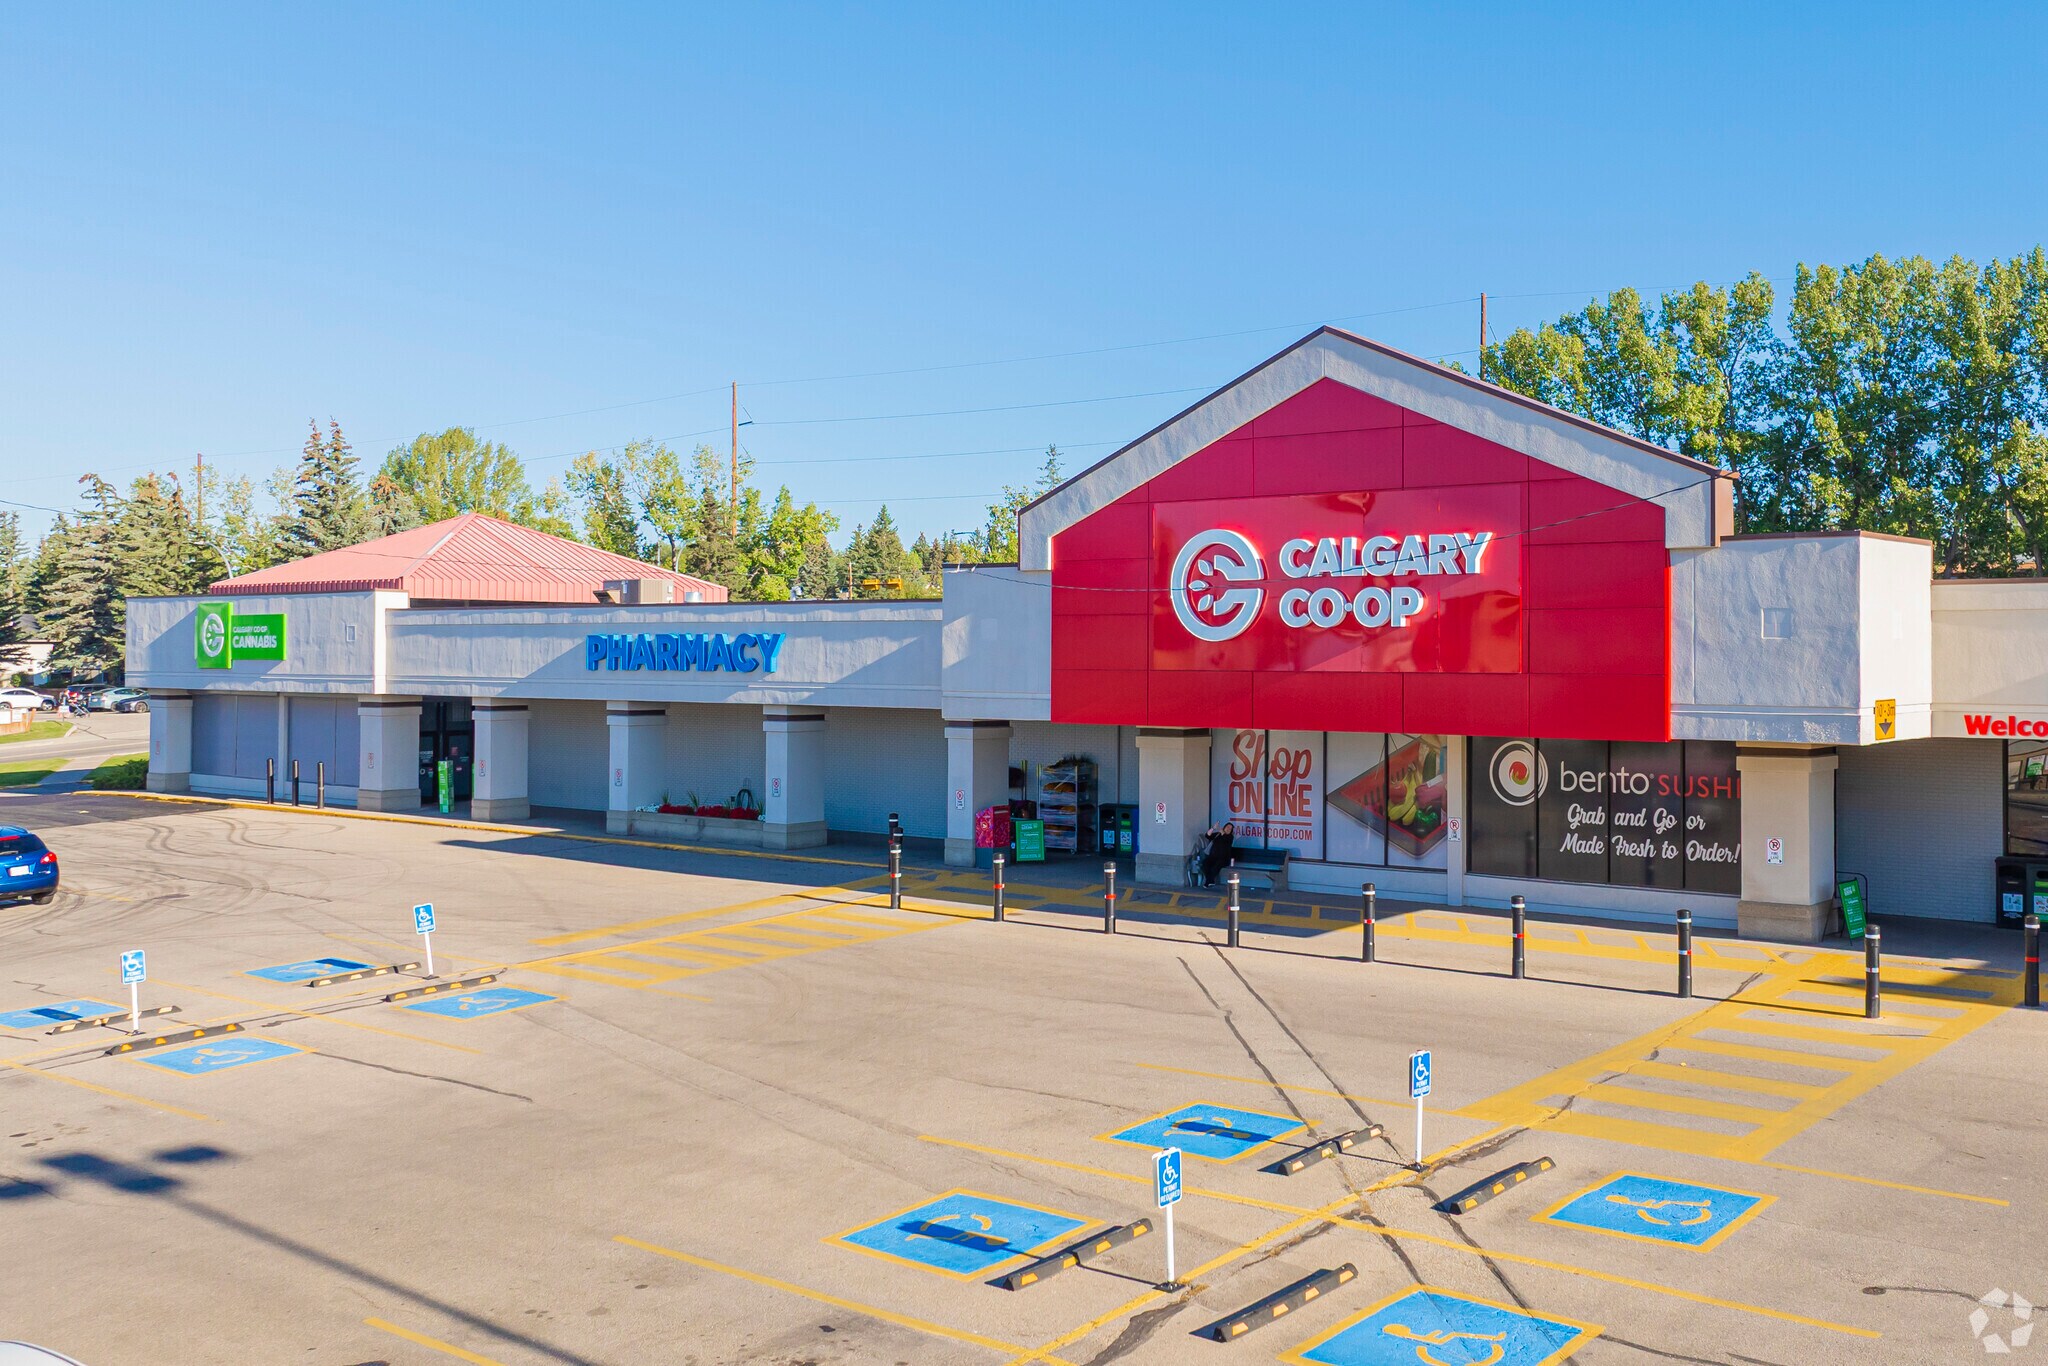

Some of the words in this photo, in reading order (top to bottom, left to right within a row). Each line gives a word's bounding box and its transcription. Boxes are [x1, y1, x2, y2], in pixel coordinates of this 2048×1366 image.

[1279, 532, 1493, 578] CALGARY
[233, 635, 277, 649] CANNABIS
[586, 633, 785, 673] PHARMACY
[1230, 729, 1312, 795] Shop
[1560, 761, 1650, 795] bento
[1658, 774, 1741, 799] SUSHI
[1228, 781, 1312, 817] ONINE
[1567, 803, 1606, 829] Grab
[1614, 808, 1647, 827] and
[1653, 808, 1678, 834] Go
[1686, 815, 1706, 831] or
[1560, 833, 1604, 855] Made
[1611, 835, 1656, 858] Fresh
[1662, 841, 1679, 859] to
[1685, 840, 1741, 864] Order!
[1163, 1182, 1178, 1194] PERMIT
